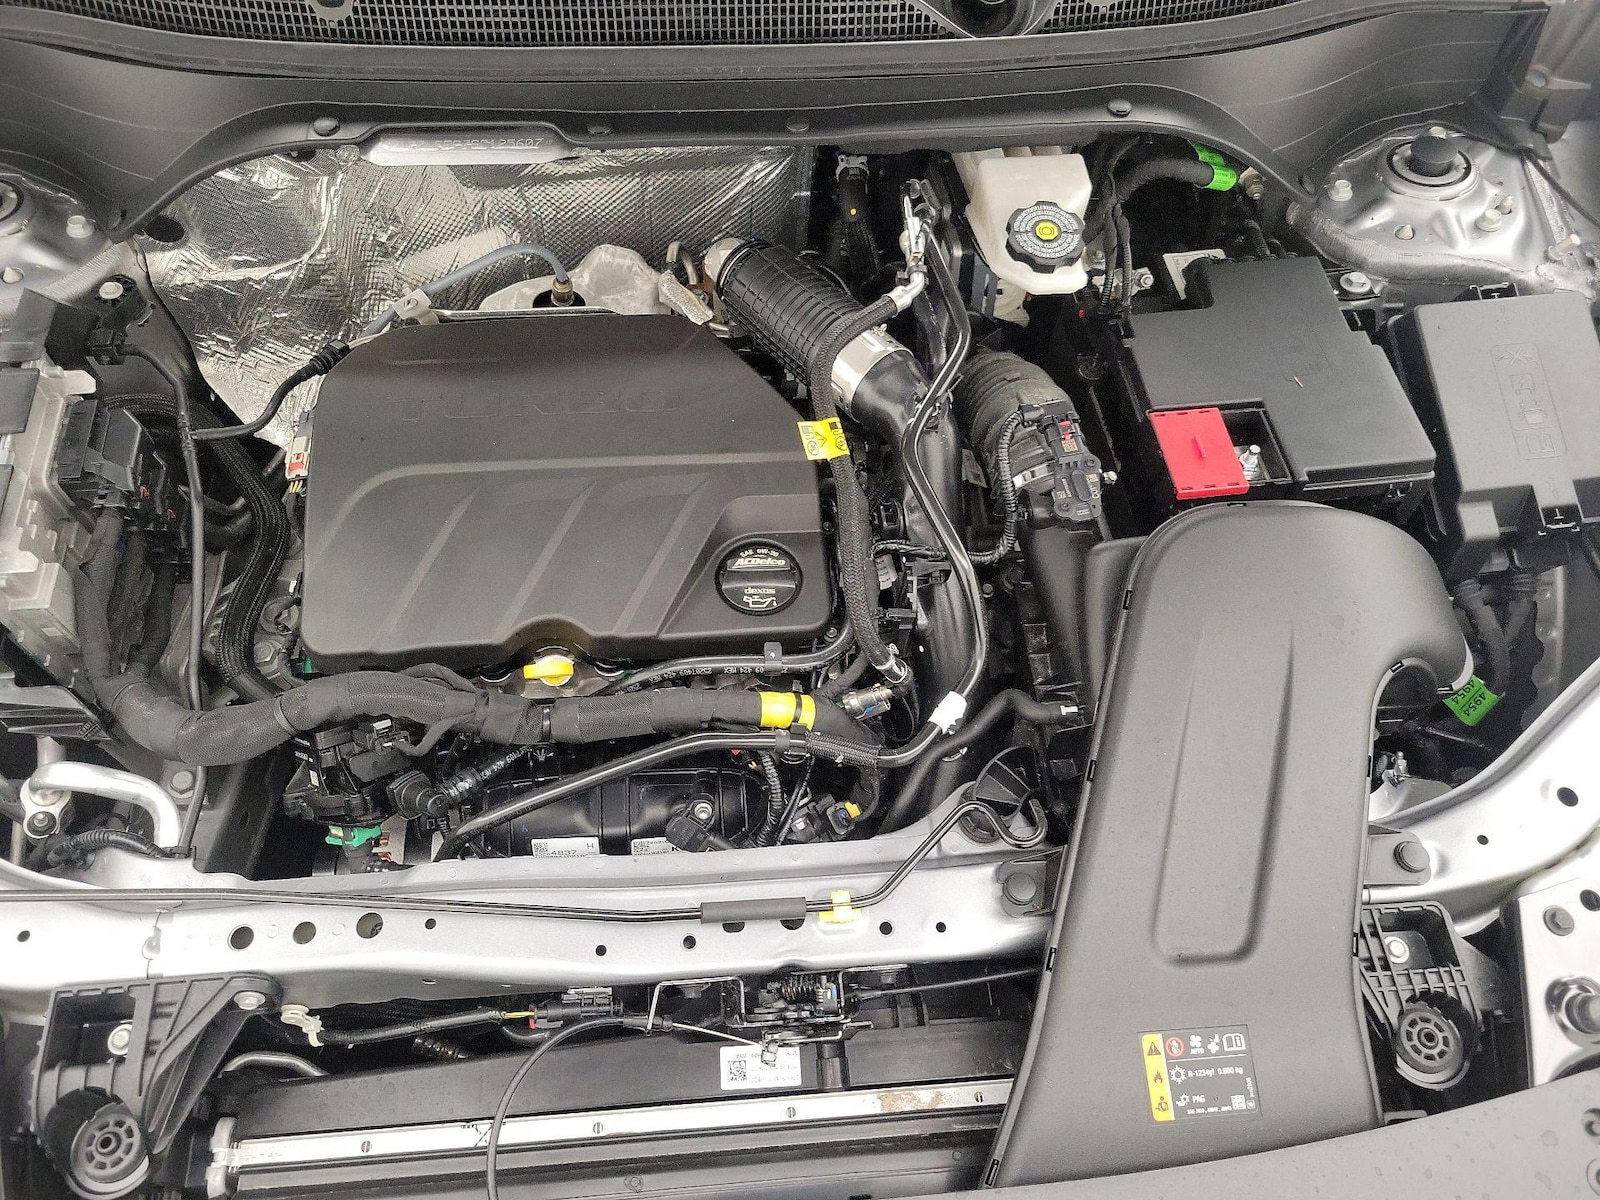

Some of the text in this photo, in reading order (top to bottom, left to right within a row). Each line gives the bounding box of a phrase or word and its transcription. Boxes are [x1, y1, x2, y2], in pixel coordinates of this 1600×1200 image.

[386, 390, 680, 423] TURBO
[733, 557, 786, 568] ACDelco
[744, 586, 776, 595] dexos
[1463, 692, 1486, 716] 4954
